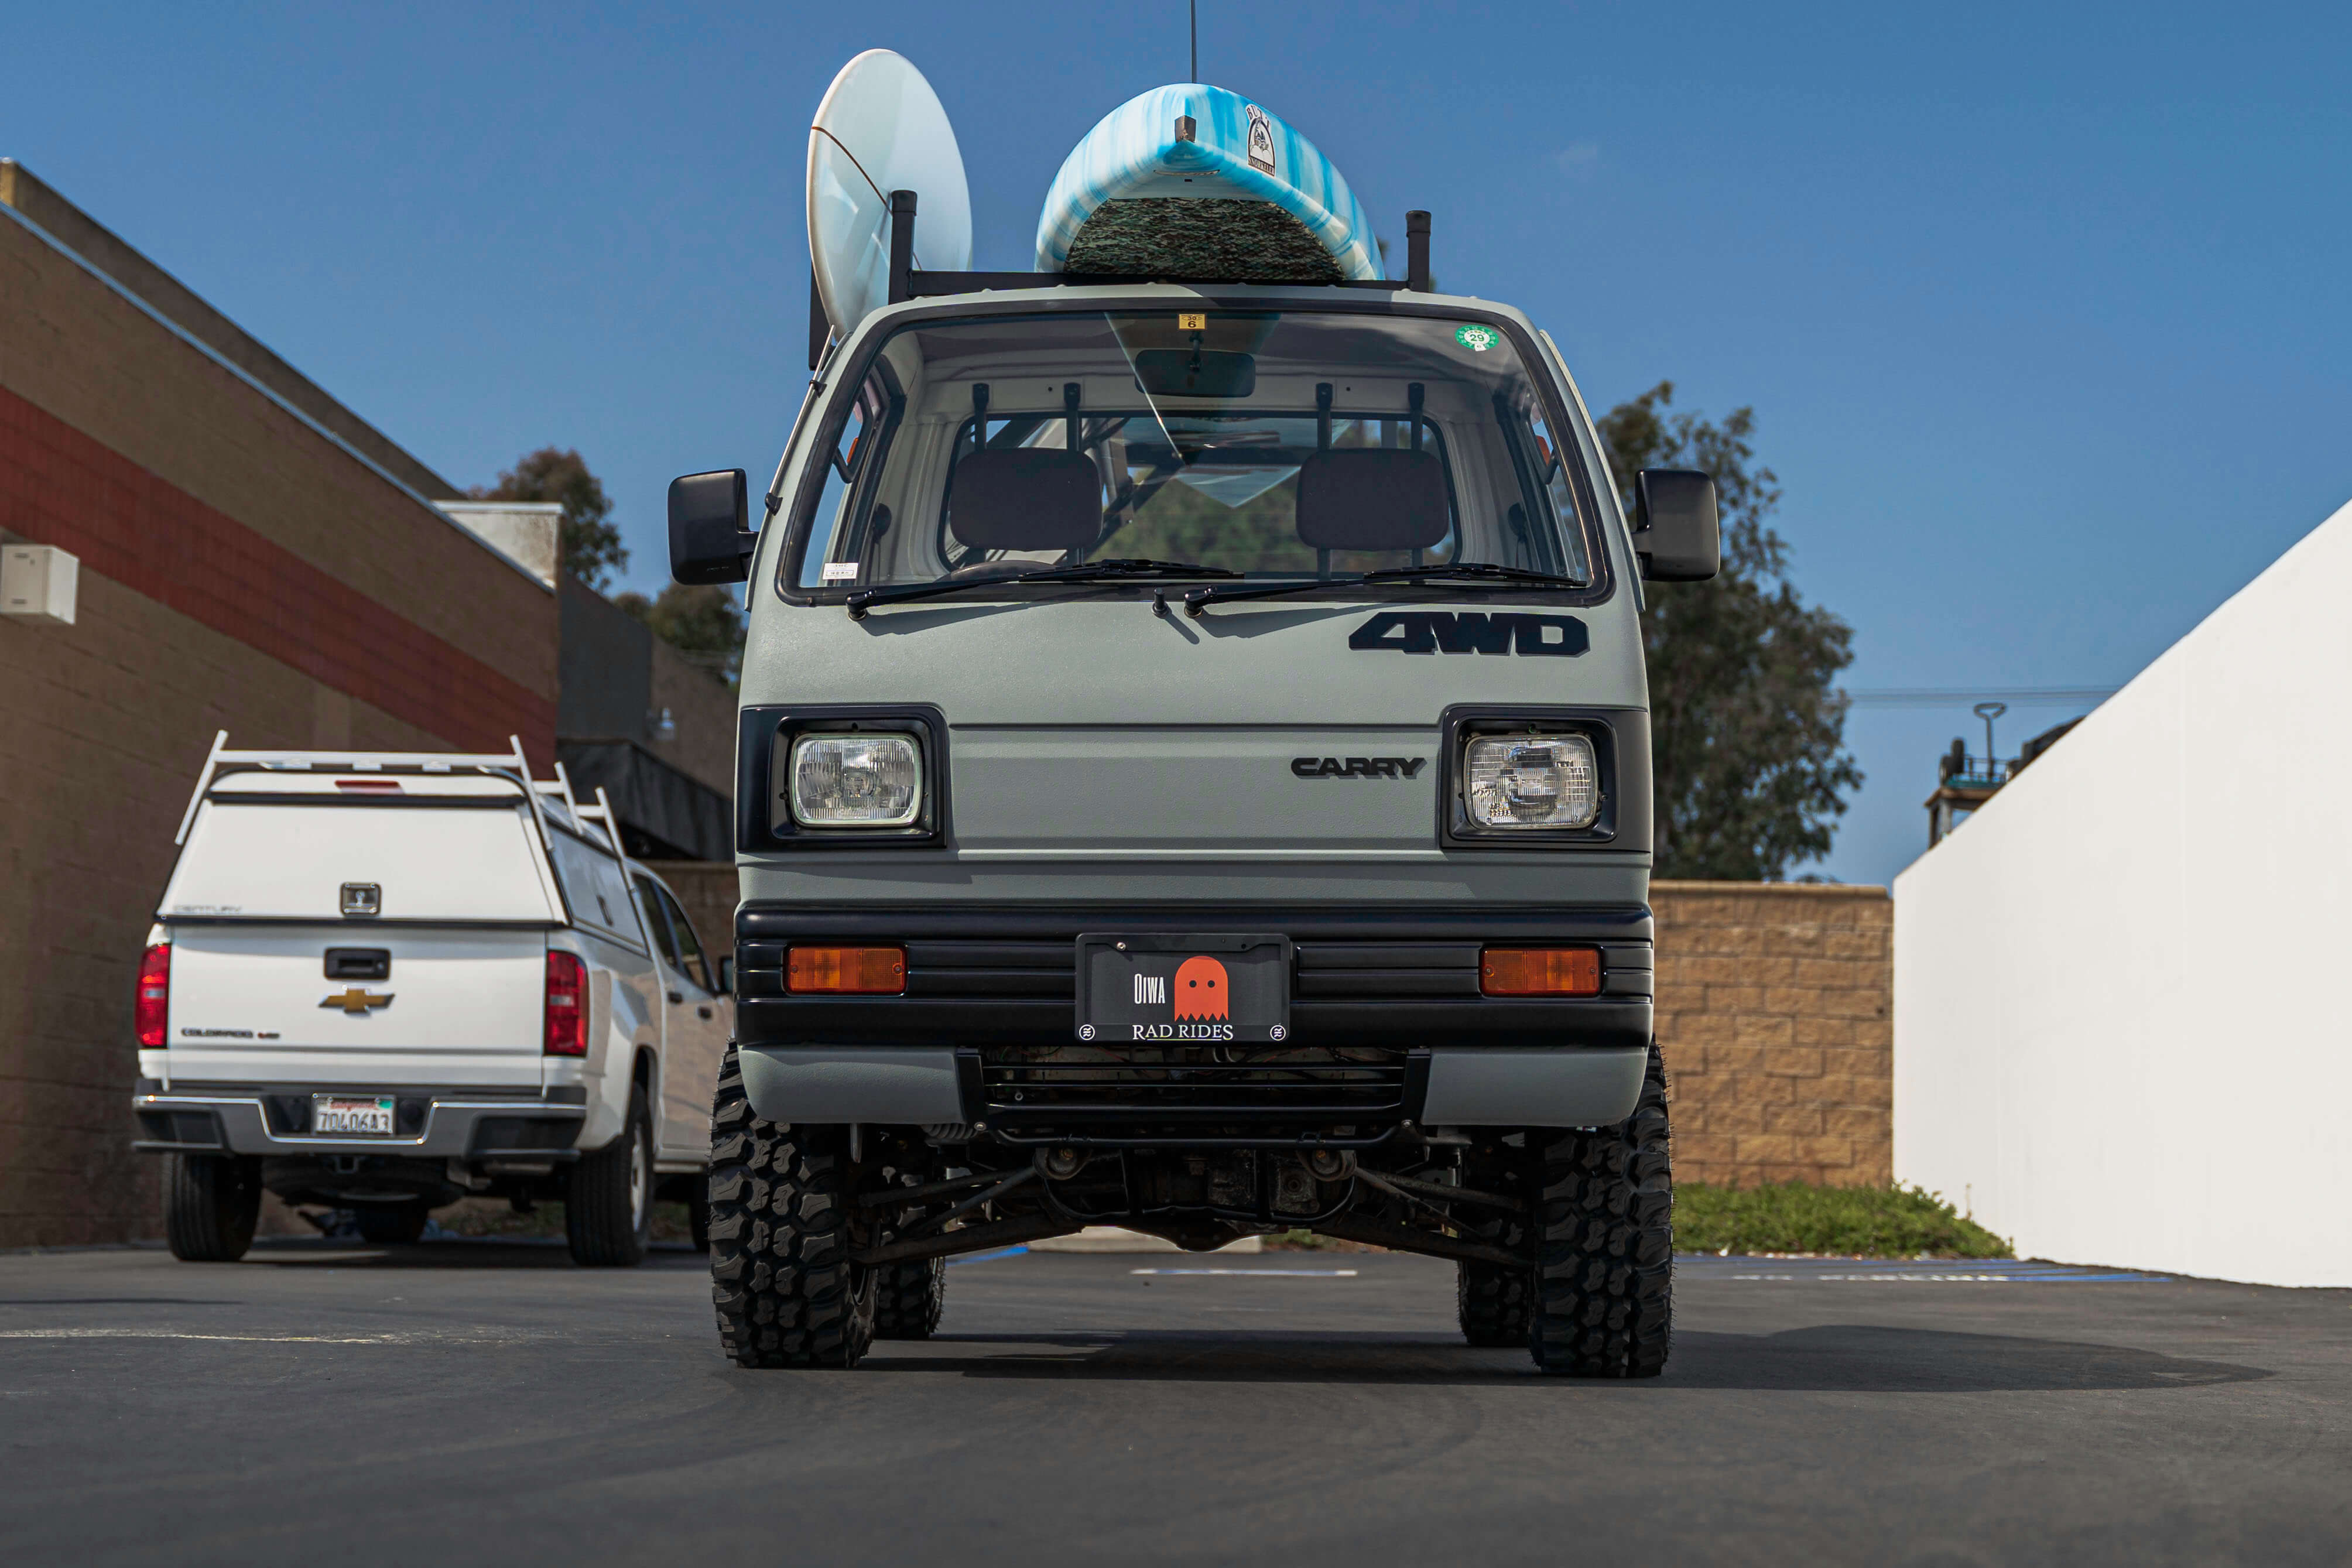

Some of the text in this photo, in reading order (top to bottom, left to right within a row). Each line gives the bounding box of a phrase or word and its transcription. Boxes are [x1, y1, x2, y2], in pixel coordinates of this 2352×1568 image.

[1470, 334, 1485, 342] 29
[1348, 612, 1590, 656] 4WD
[1290, 758, 1427, 777] CARRY
[1132, 1025, 1234, 1040] RAD RIDES
